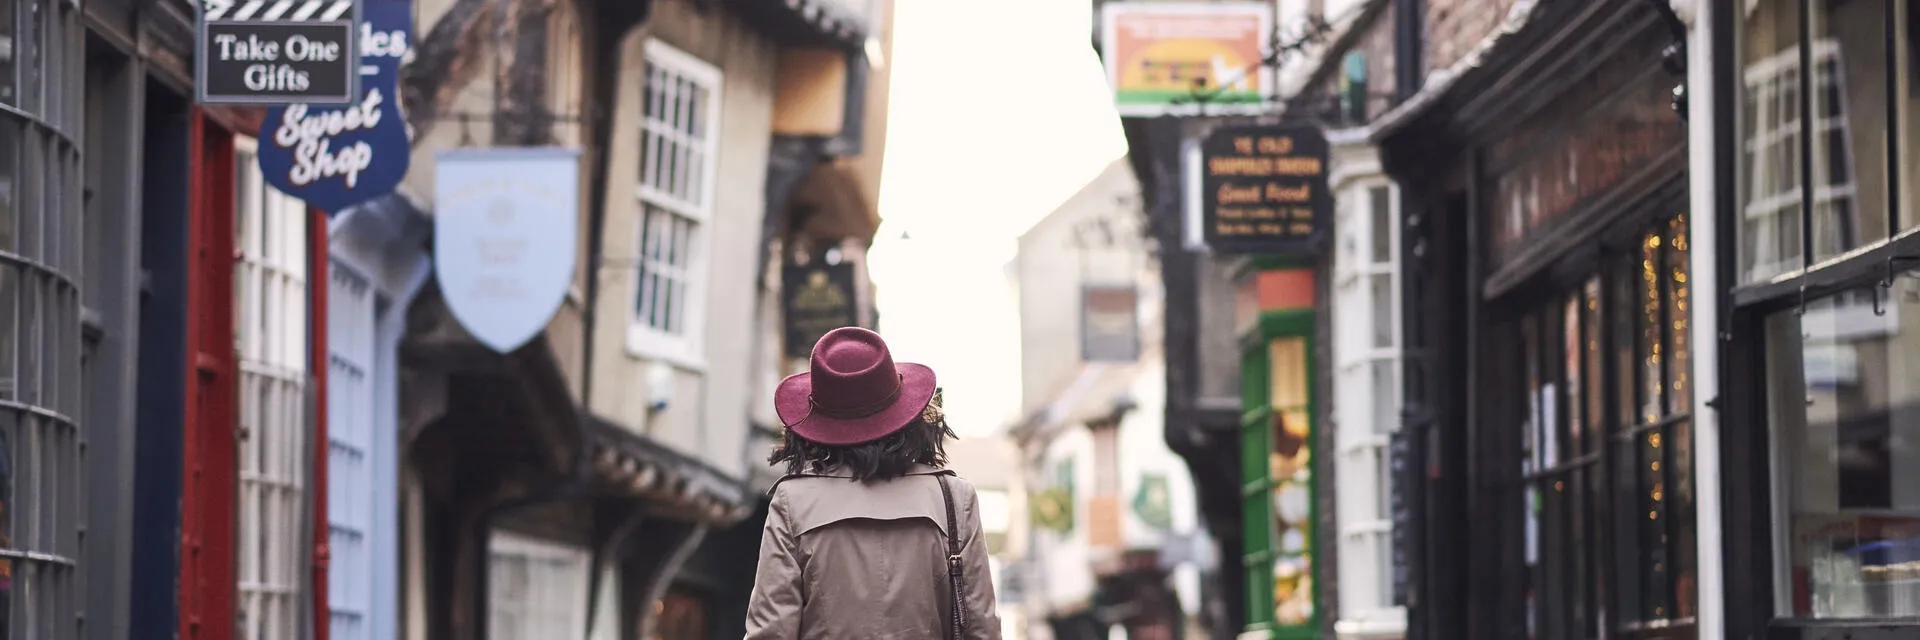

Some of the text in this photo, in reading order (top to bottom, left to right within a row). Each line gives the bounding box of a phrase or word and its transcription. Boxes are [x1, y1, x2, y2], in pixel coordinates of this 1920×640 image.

[215, 34, 340, 61] Take One
[243, 64, 310, 91] Gifts
[275, 88, 383, 147] Sweet
[290, 138, 372, 188] Shop
